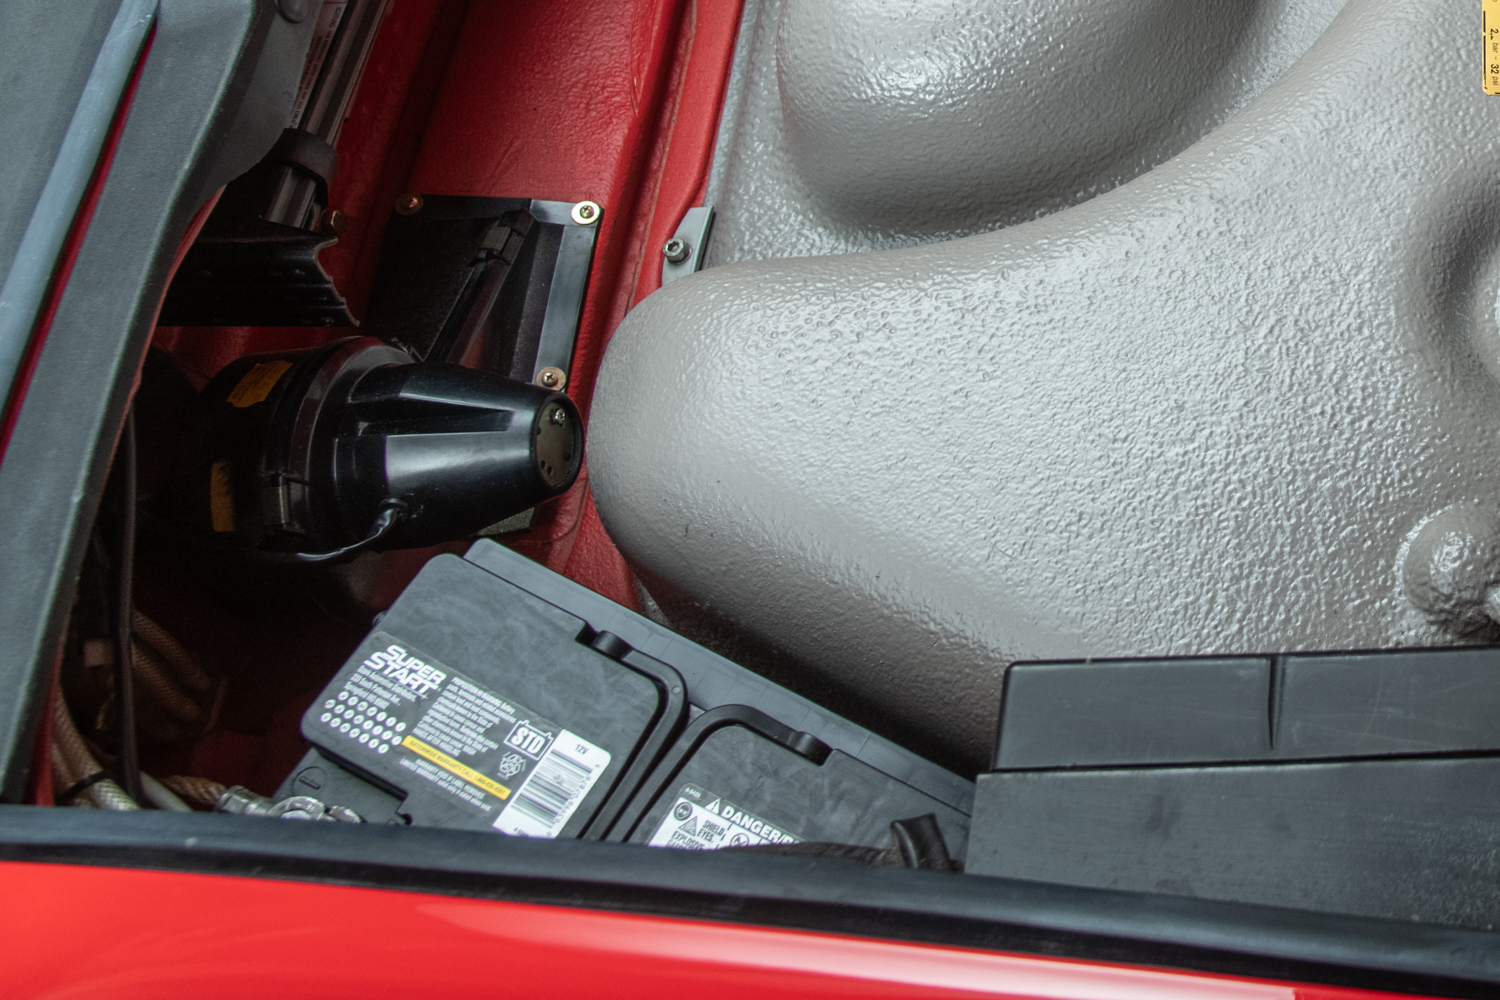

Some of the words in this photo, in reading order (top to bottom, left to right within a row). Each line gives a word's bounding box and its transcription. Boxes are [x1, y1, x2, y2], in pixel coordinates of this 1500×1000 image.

[1491, 42, 1499, 53] bar
[1490, 63, 1499, 74] 32
[1491, 75, 1500, 86] psi
[384, 644, 447, 684] SUPER
[363, 651, 439, 694] START
[511, 727, 546, 754] STD
[574, 743, 590, 755] 12V
[702, 820, 725, 836] SHIELD
